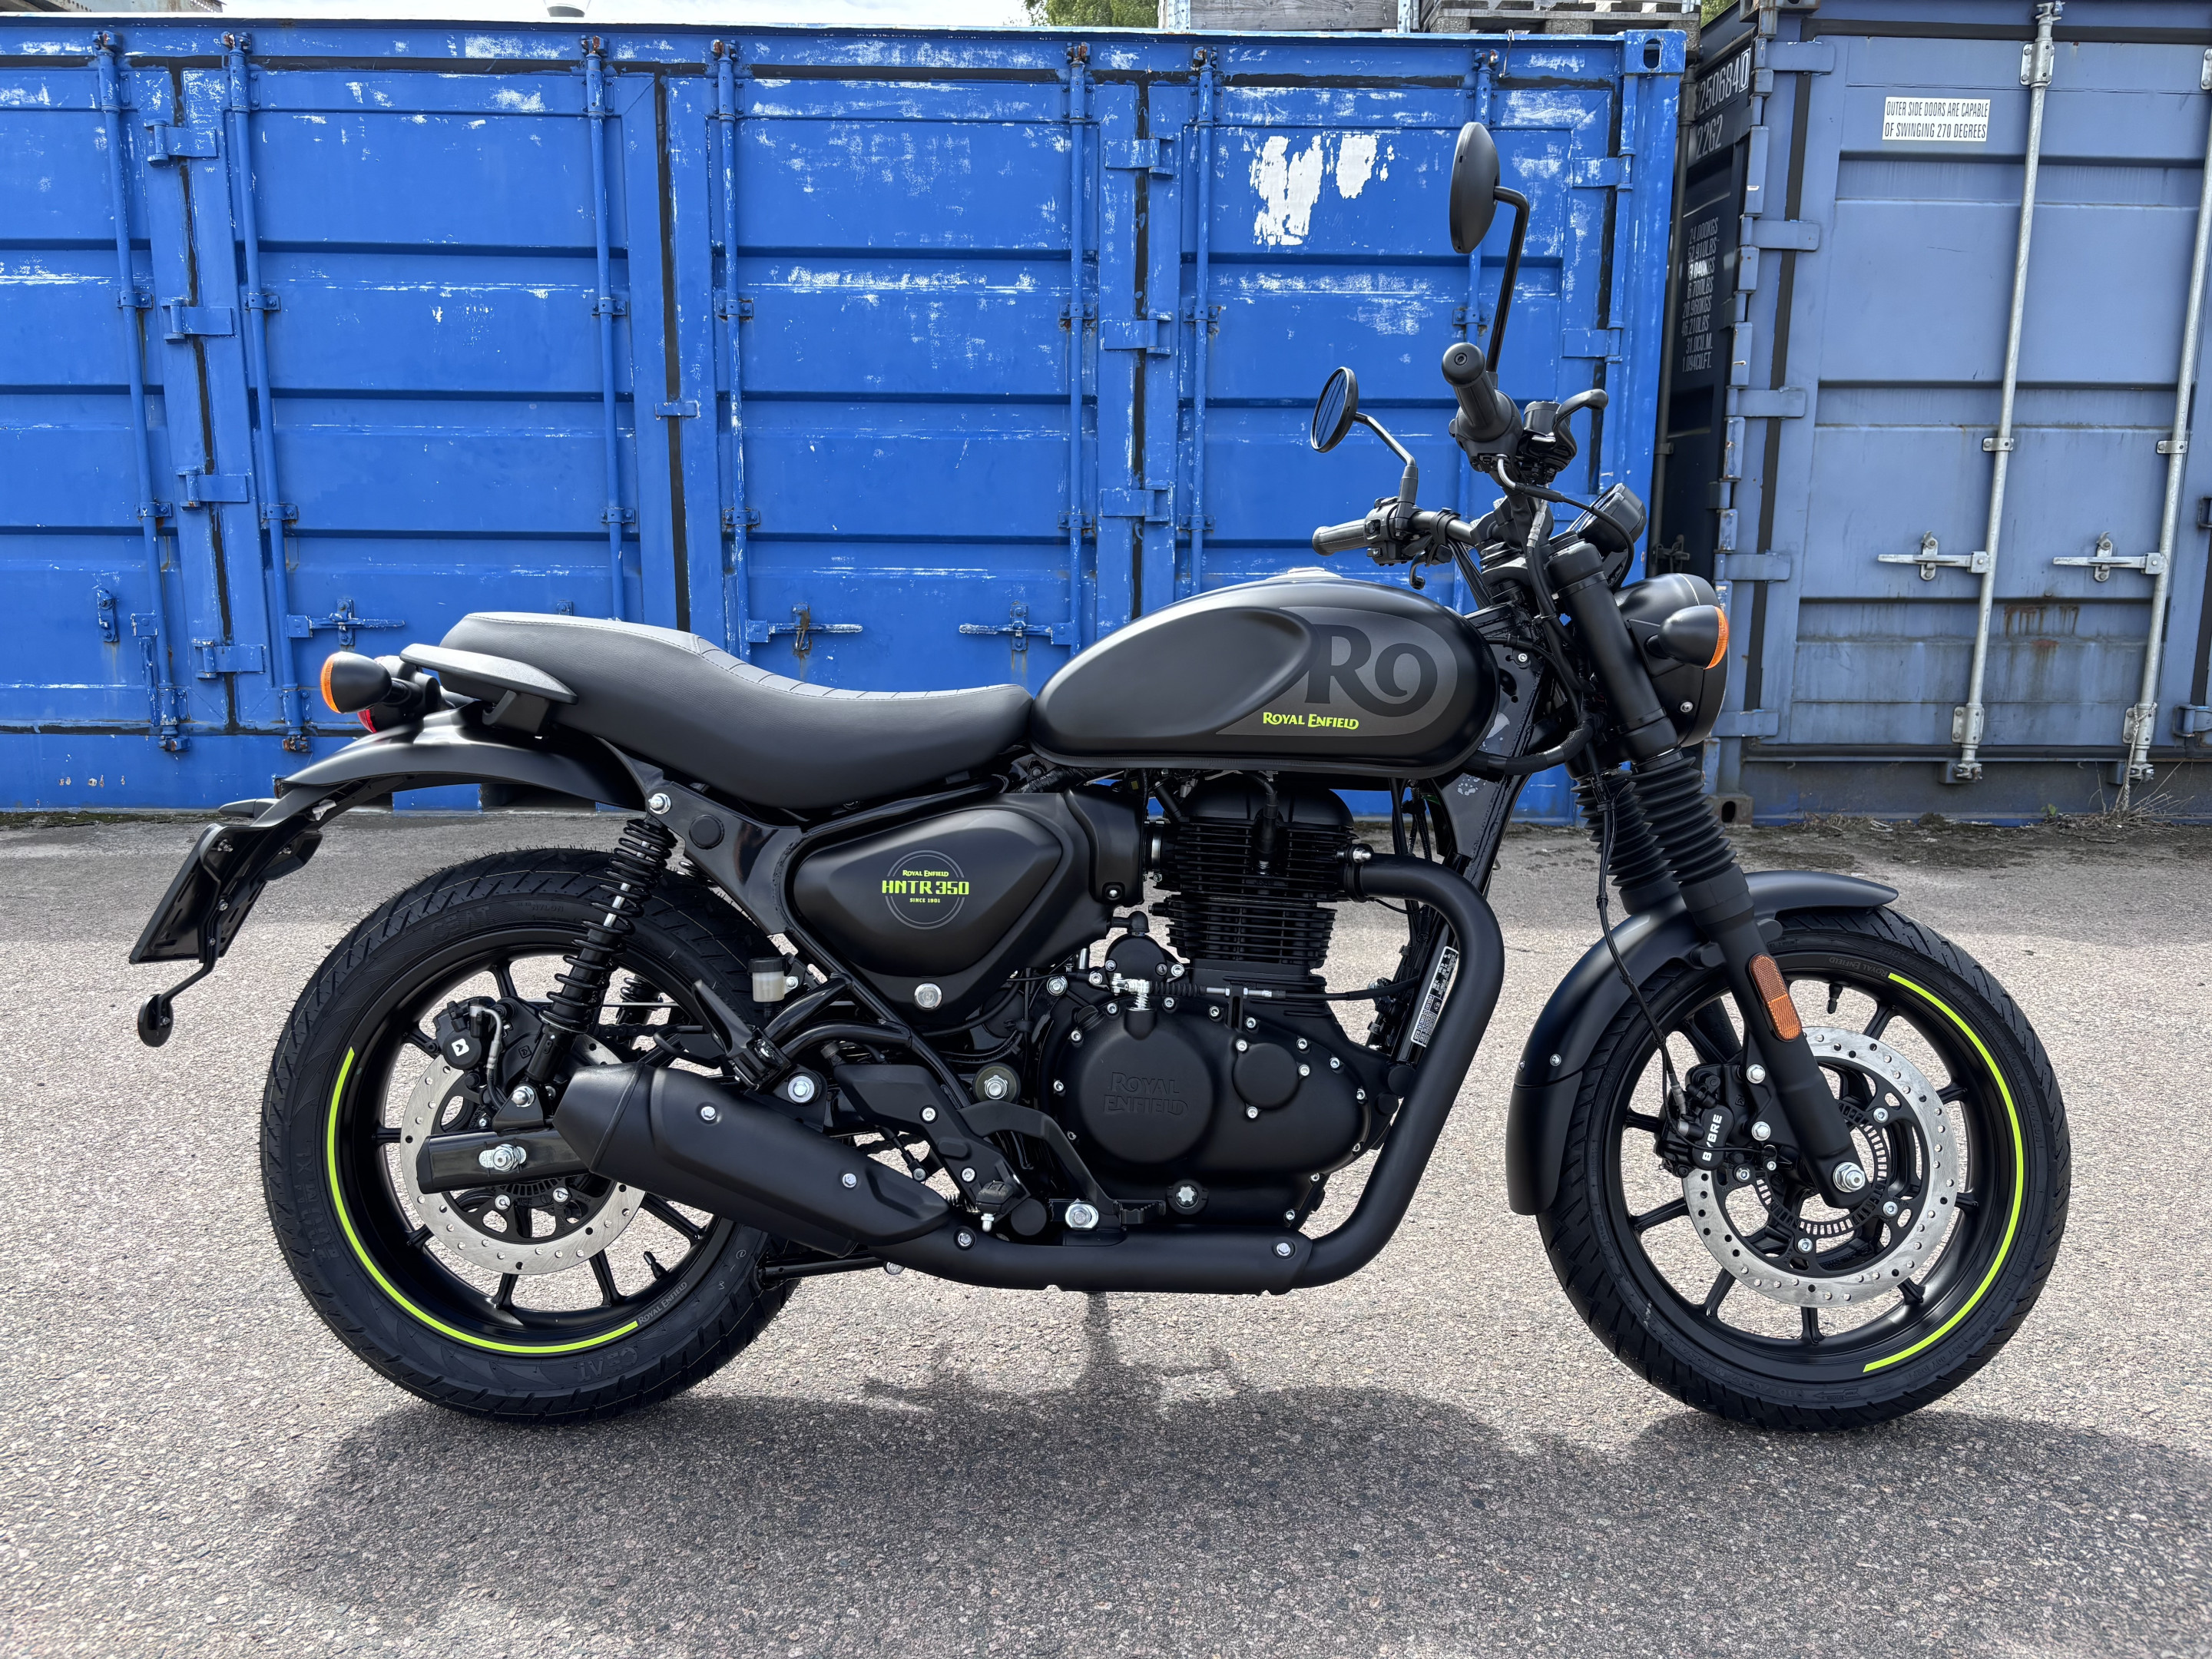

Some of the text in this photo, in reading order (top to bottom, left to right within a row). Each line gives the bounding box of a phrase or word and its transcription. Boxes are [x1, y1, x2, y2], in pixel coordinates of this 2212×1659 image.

[1886, 101, 1988, 118] OUTER SIDE DOORS ARE CAPABLE
[1696, 114, 1723, 161] 22G2
[1885, 122, 1986, 138] OF SWINGING 270 DEGREES
[1263, 711, 1359, 730] ROYAL ENFIELD
[882, 880, 969, 895] HNTR 350
[1111, 1071, 1180, 1094] ROYAL
[1104, 1094, 1189, 1115] ENFIELD
[637, 1282, 687, 1324] ROYAL ENFIELD
